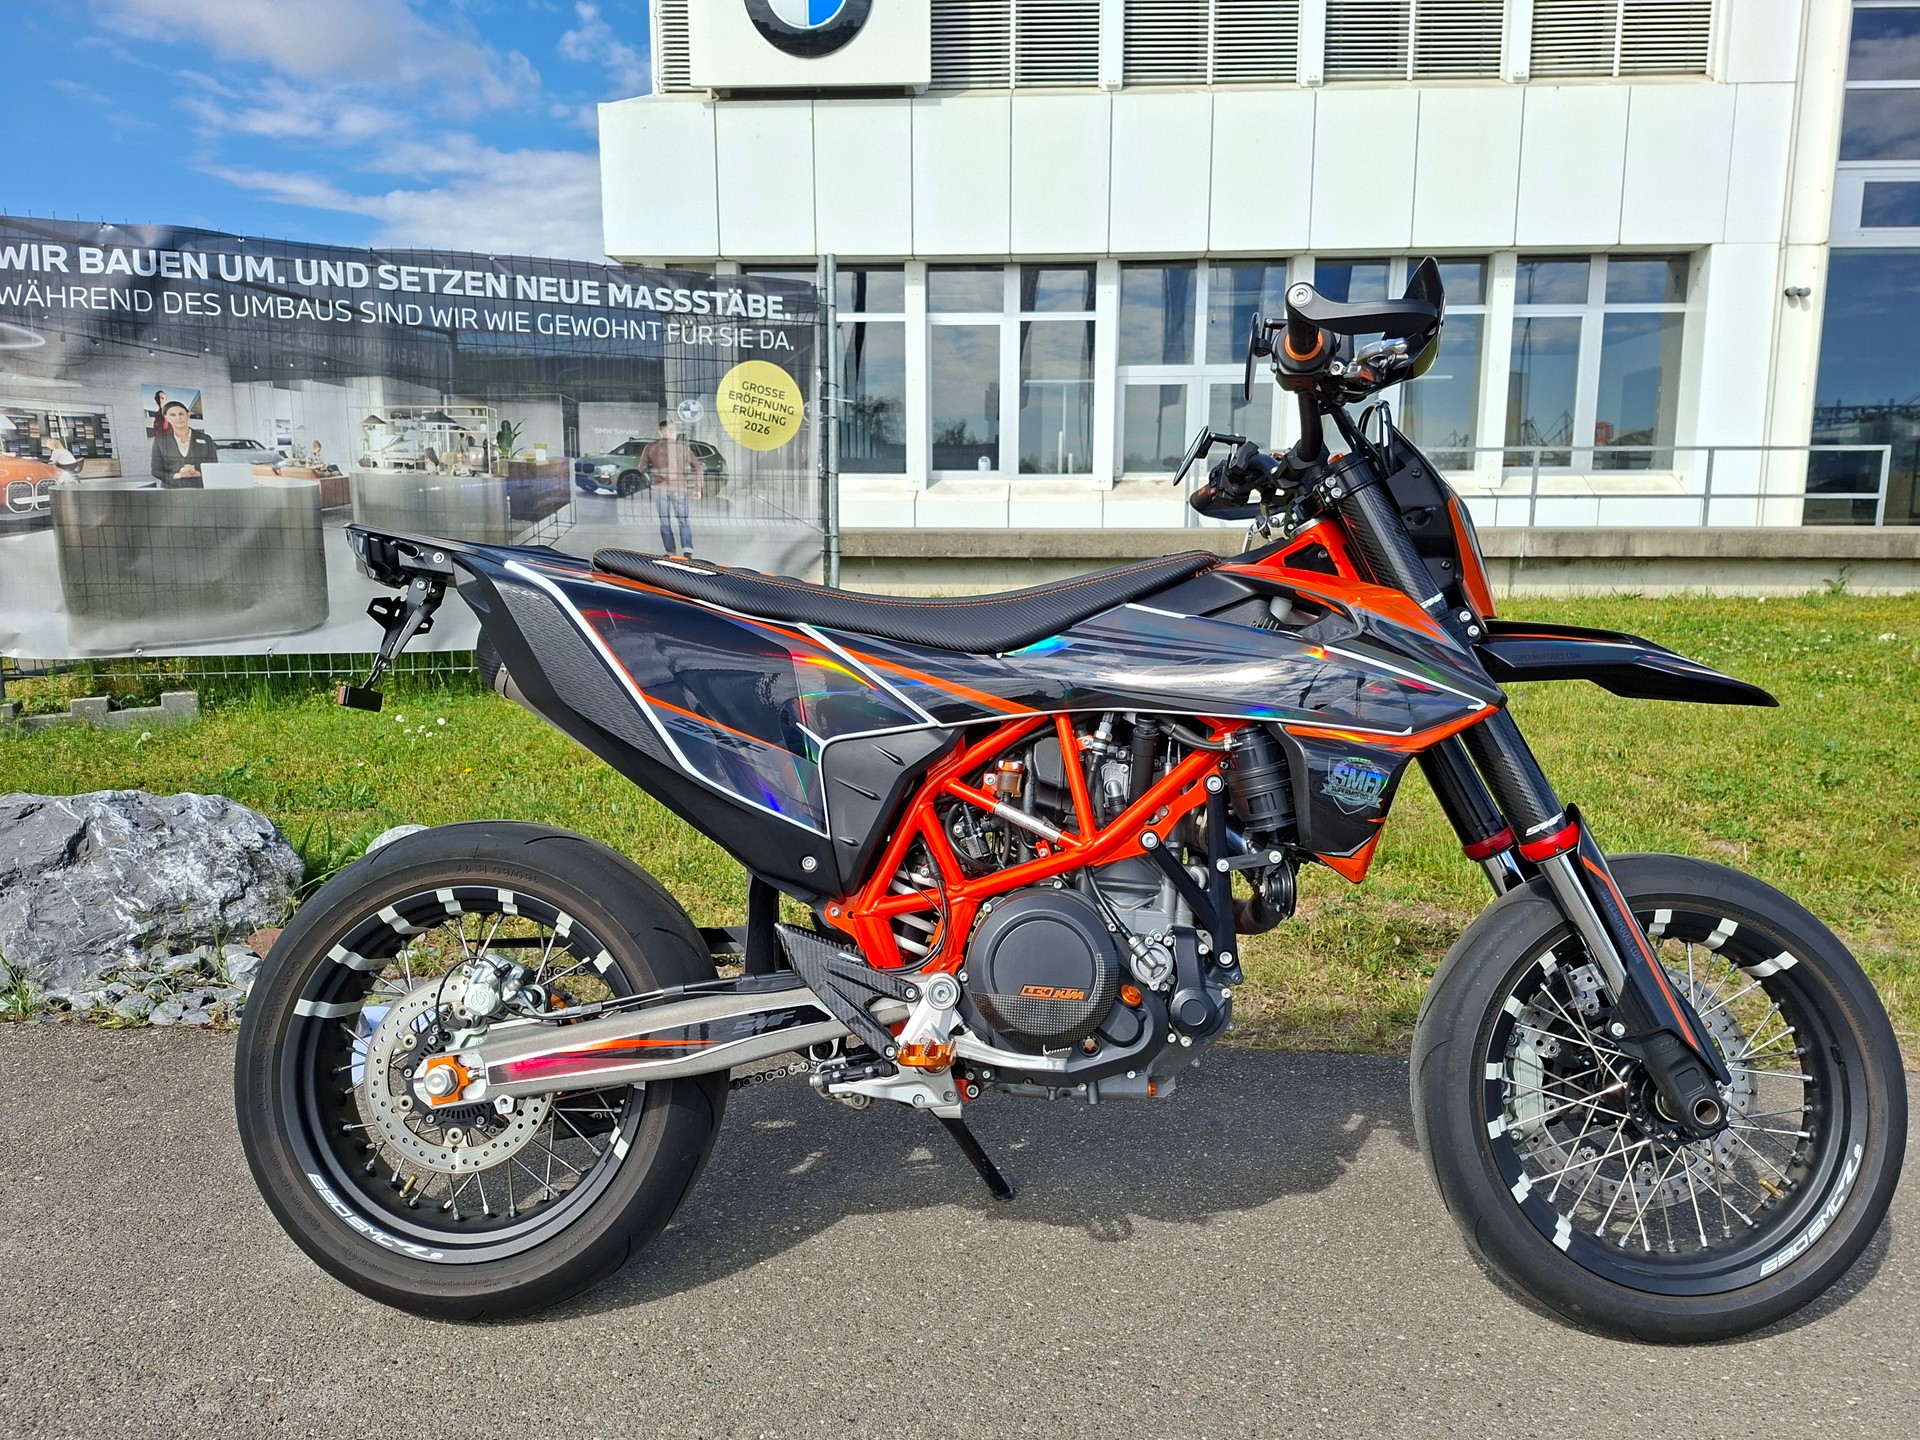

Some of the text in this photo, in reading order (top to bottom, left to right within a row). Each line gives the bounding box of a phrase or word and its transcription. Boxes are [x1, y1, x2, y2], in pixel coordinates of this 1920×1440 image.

[0, 242, 791, 321] WIR BAUEN UM. UND SETZEN NEUE MASSSTÄBE.
[0, 279, 795, 351] WÄHREND DES UMBAUS SIND WIR WIE GEWOHNT FÜR SIE DA.
[742, 380, 785, 400] GROSSE
[728, 390, 795, 416] ERÖFFNUNG
[732, 404, 786, 426] FRÜHLING
[613, 427, 640, 436] Service
[743, 420, 770, 435] 2026
[1053, 989, 1086, 1000] KTM
